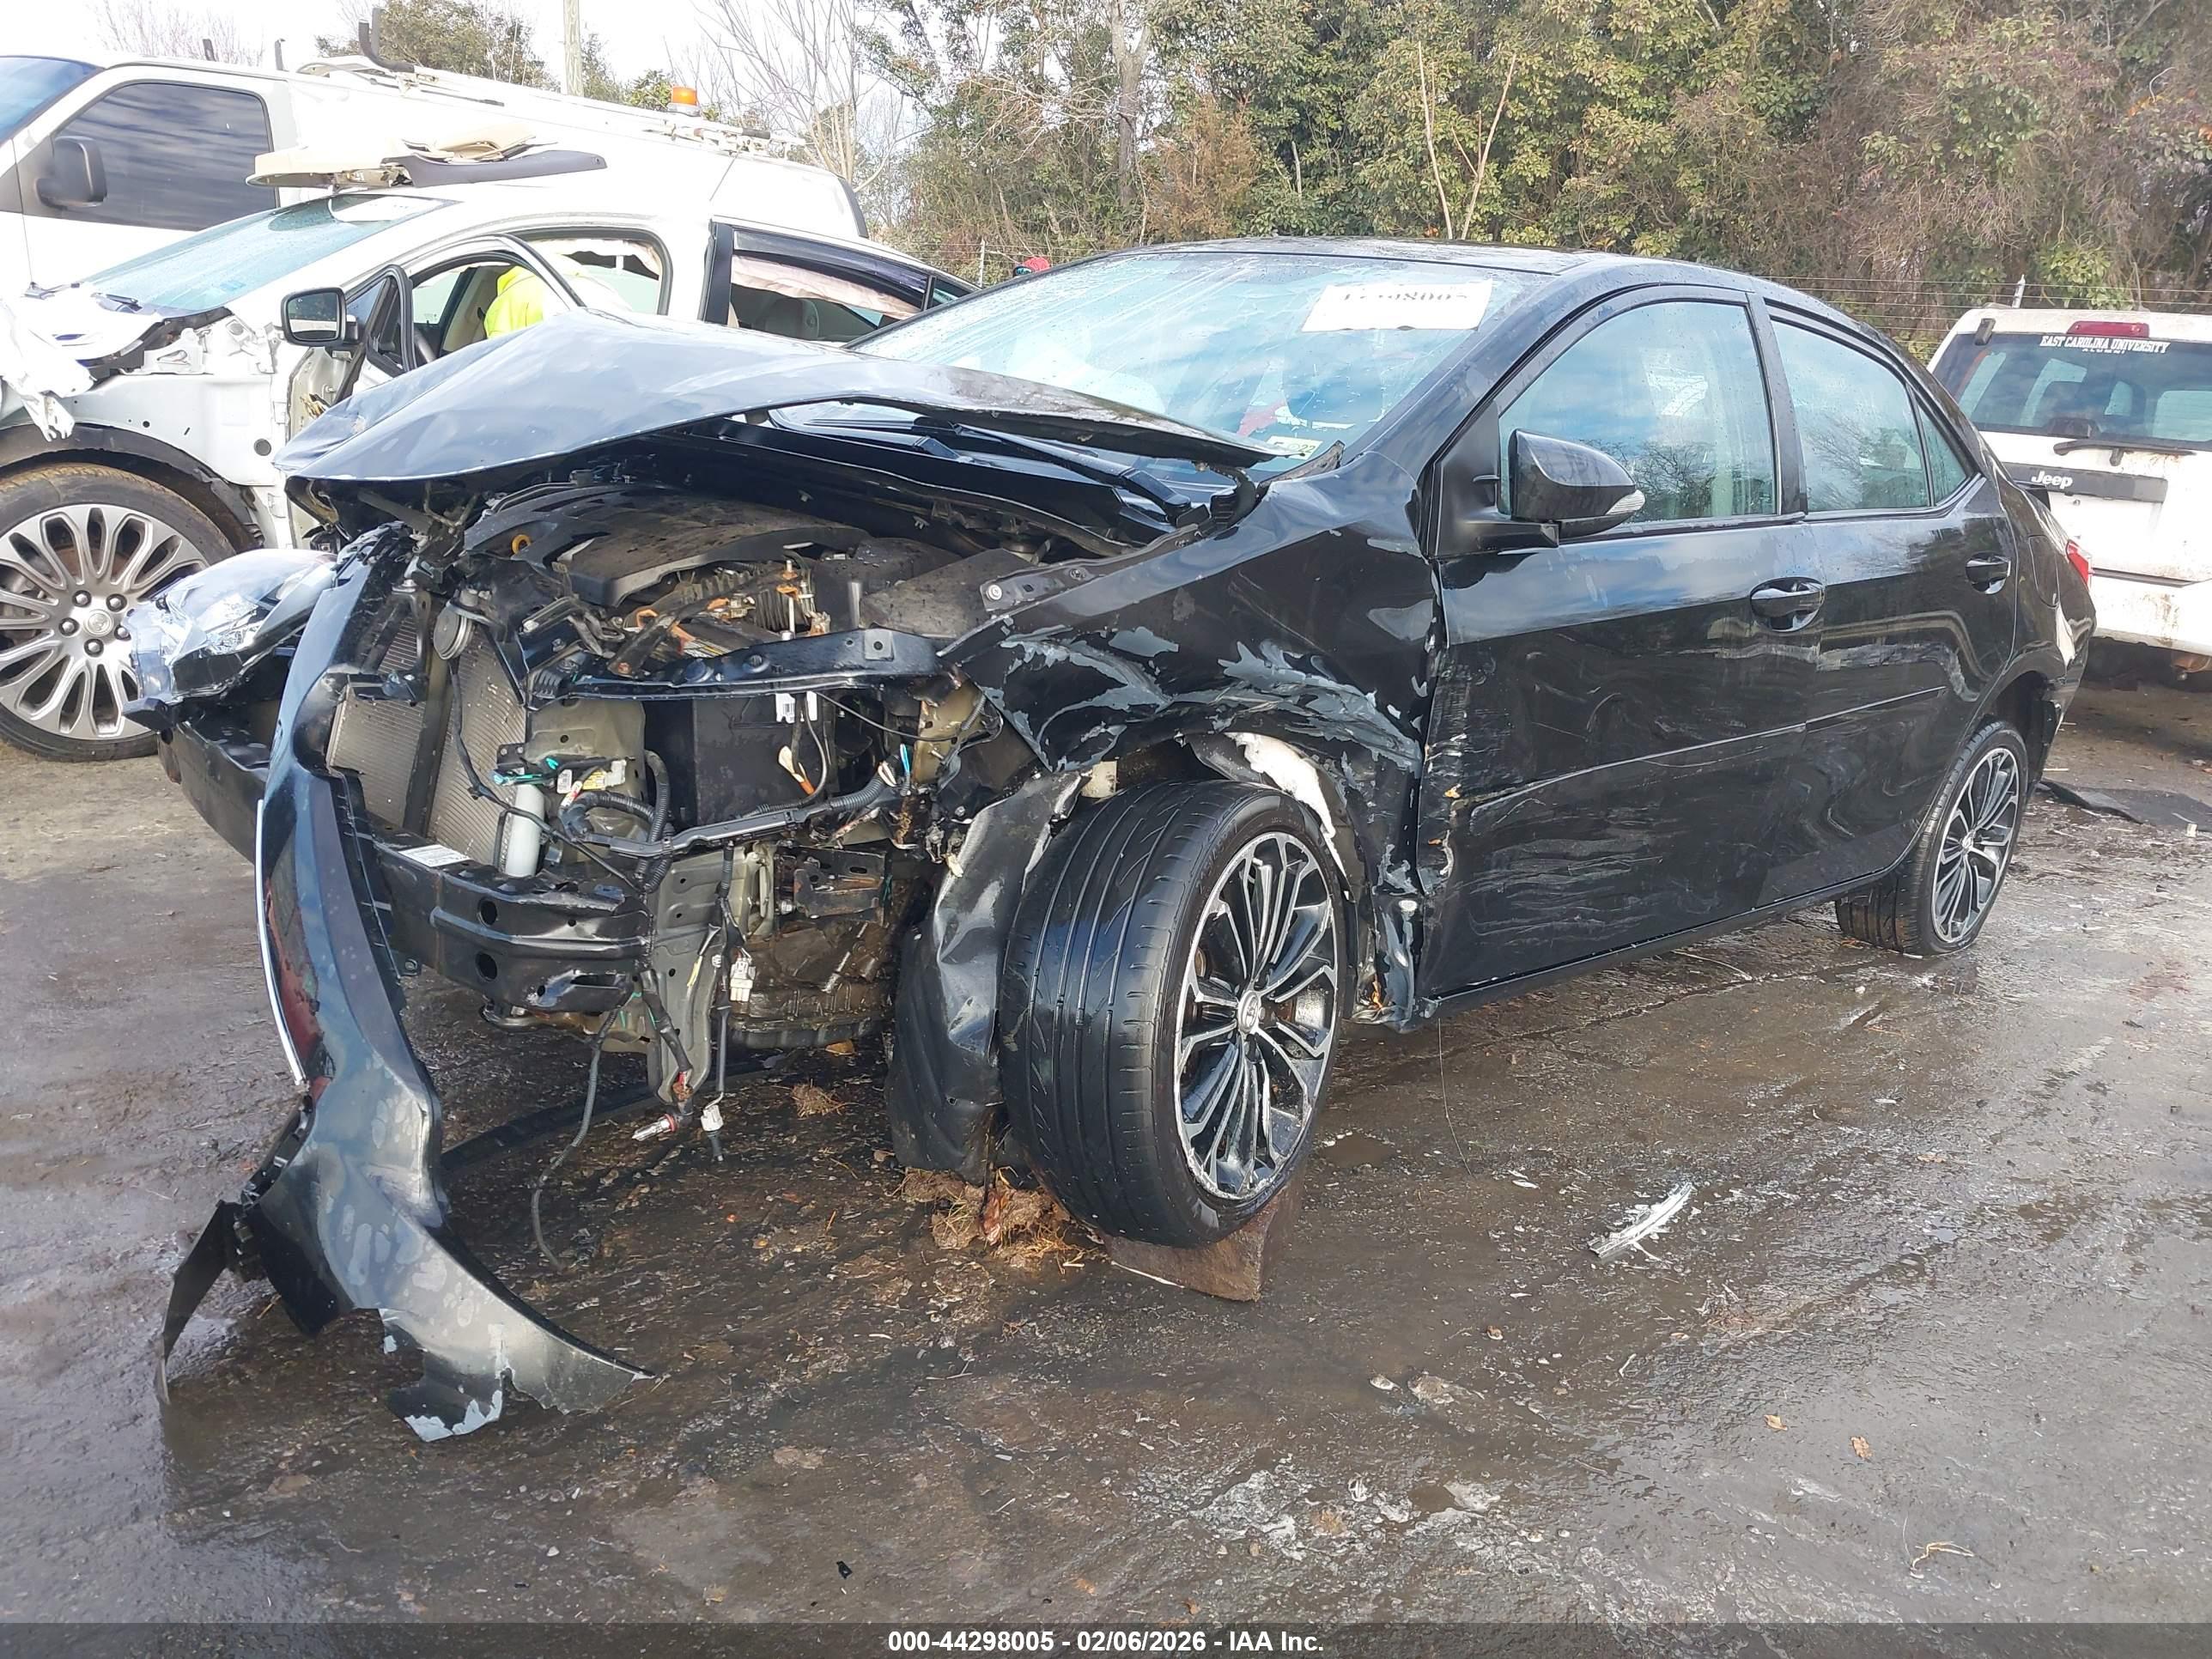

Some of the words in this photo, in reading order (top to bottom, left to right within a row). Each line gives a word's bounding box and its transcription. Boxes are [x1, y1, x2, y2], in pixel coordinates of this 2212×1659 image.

[2040, 336, 2066, 347] EAST
[2064, 336, 2111, 349] CAROLINA
[2111, 338, 2171, 353] UNIVERSITY
[2031, 471, 2073, 489] Jeep
